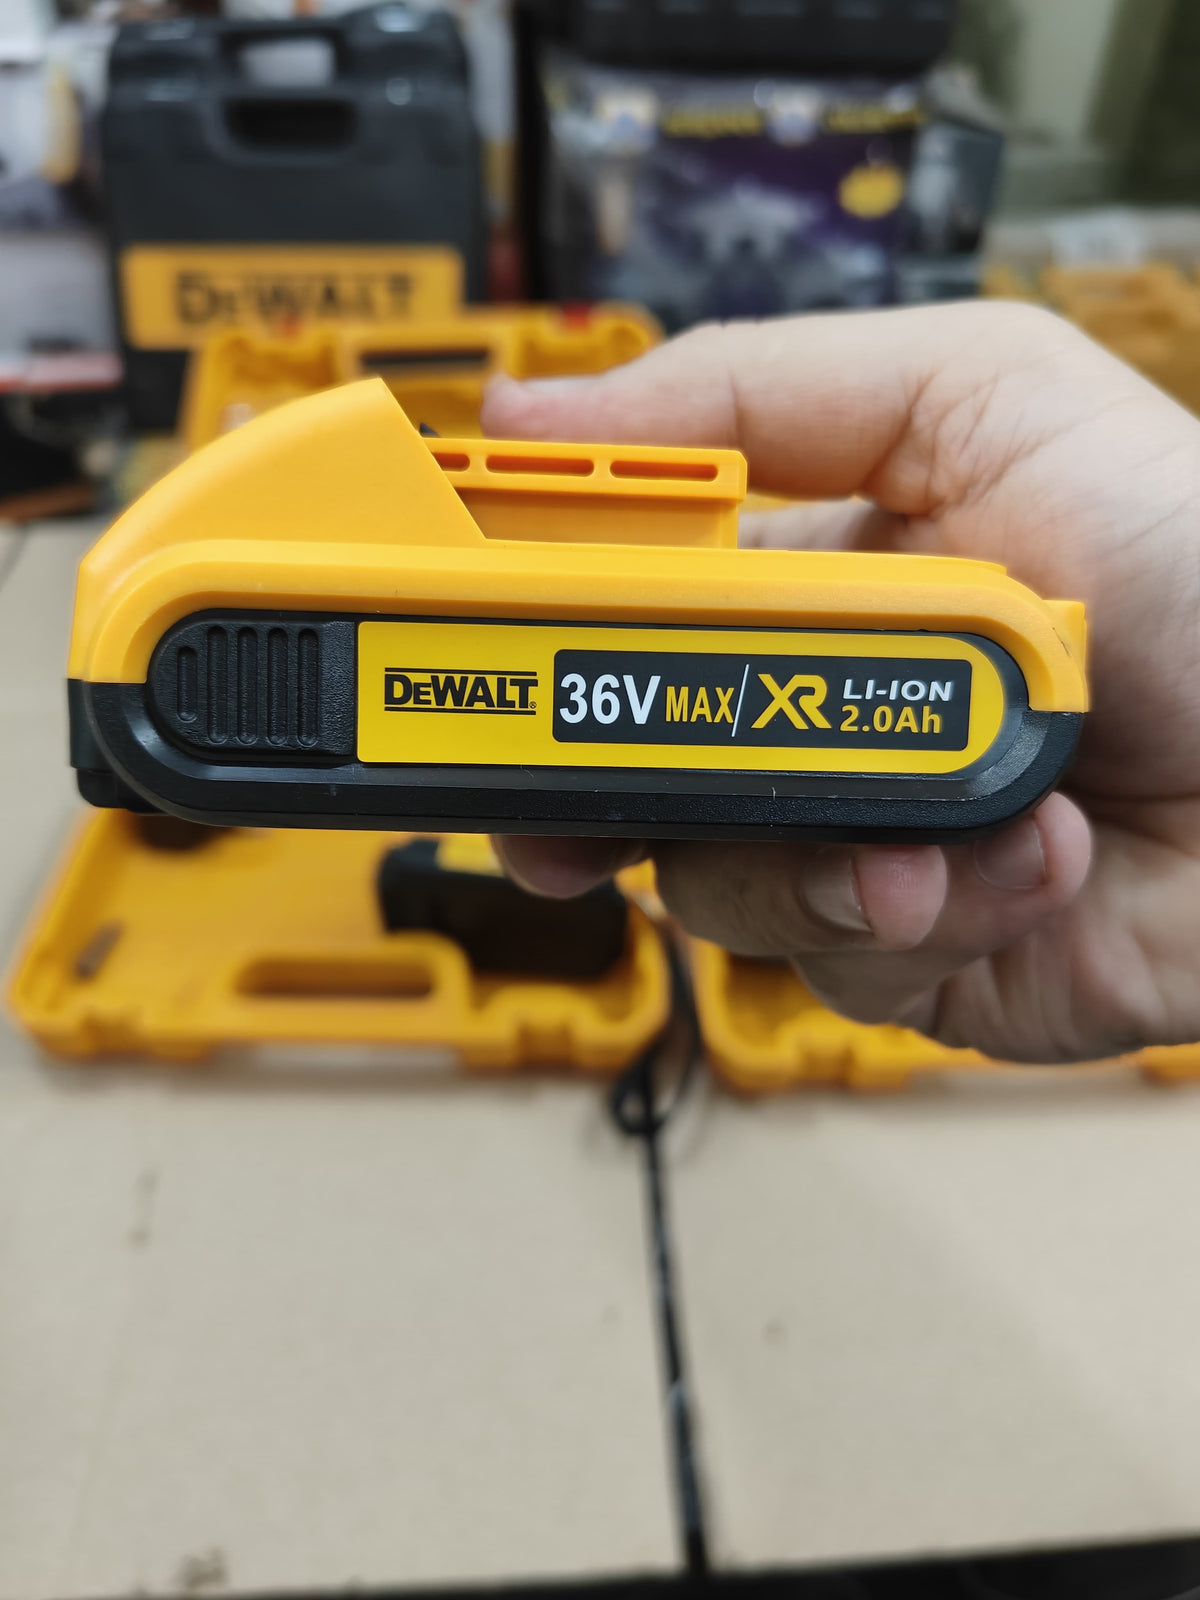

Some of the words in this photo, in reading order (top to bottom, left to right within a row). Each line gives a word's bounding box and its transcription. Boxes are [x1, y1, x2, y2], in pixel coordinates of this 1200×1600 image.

[559, 673, 661, 725] 36V
[751, 674, 831, 729] XR
[843, 679, 953, 702] LI-ION
[840, 705, 943, 734] 2.0Ah
